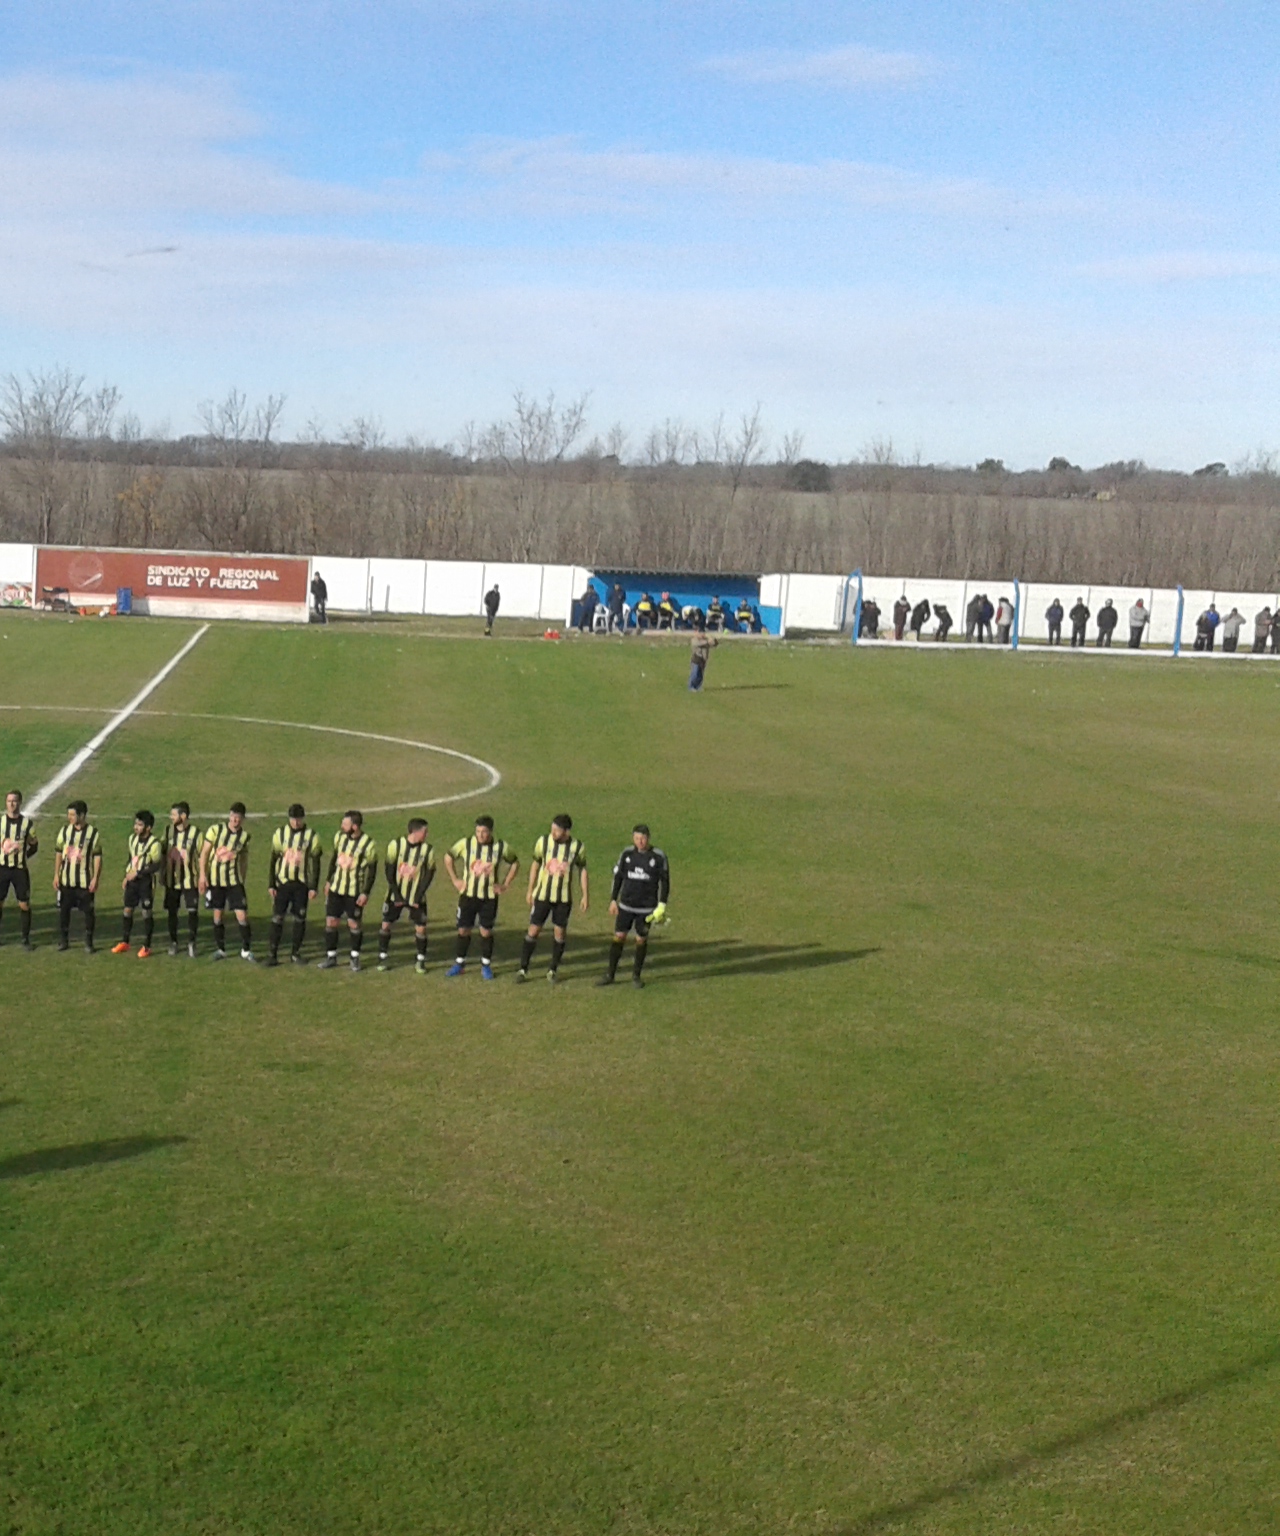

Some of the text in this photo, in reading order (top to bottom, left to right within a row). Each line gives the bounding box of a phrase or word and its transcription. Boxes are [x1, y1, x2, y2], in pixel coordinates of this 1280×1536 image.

[147, 565, 280, 580] SINDICATO REGIONAL
[147, 575, 259, 590] DE LUZ Y FUERZA
